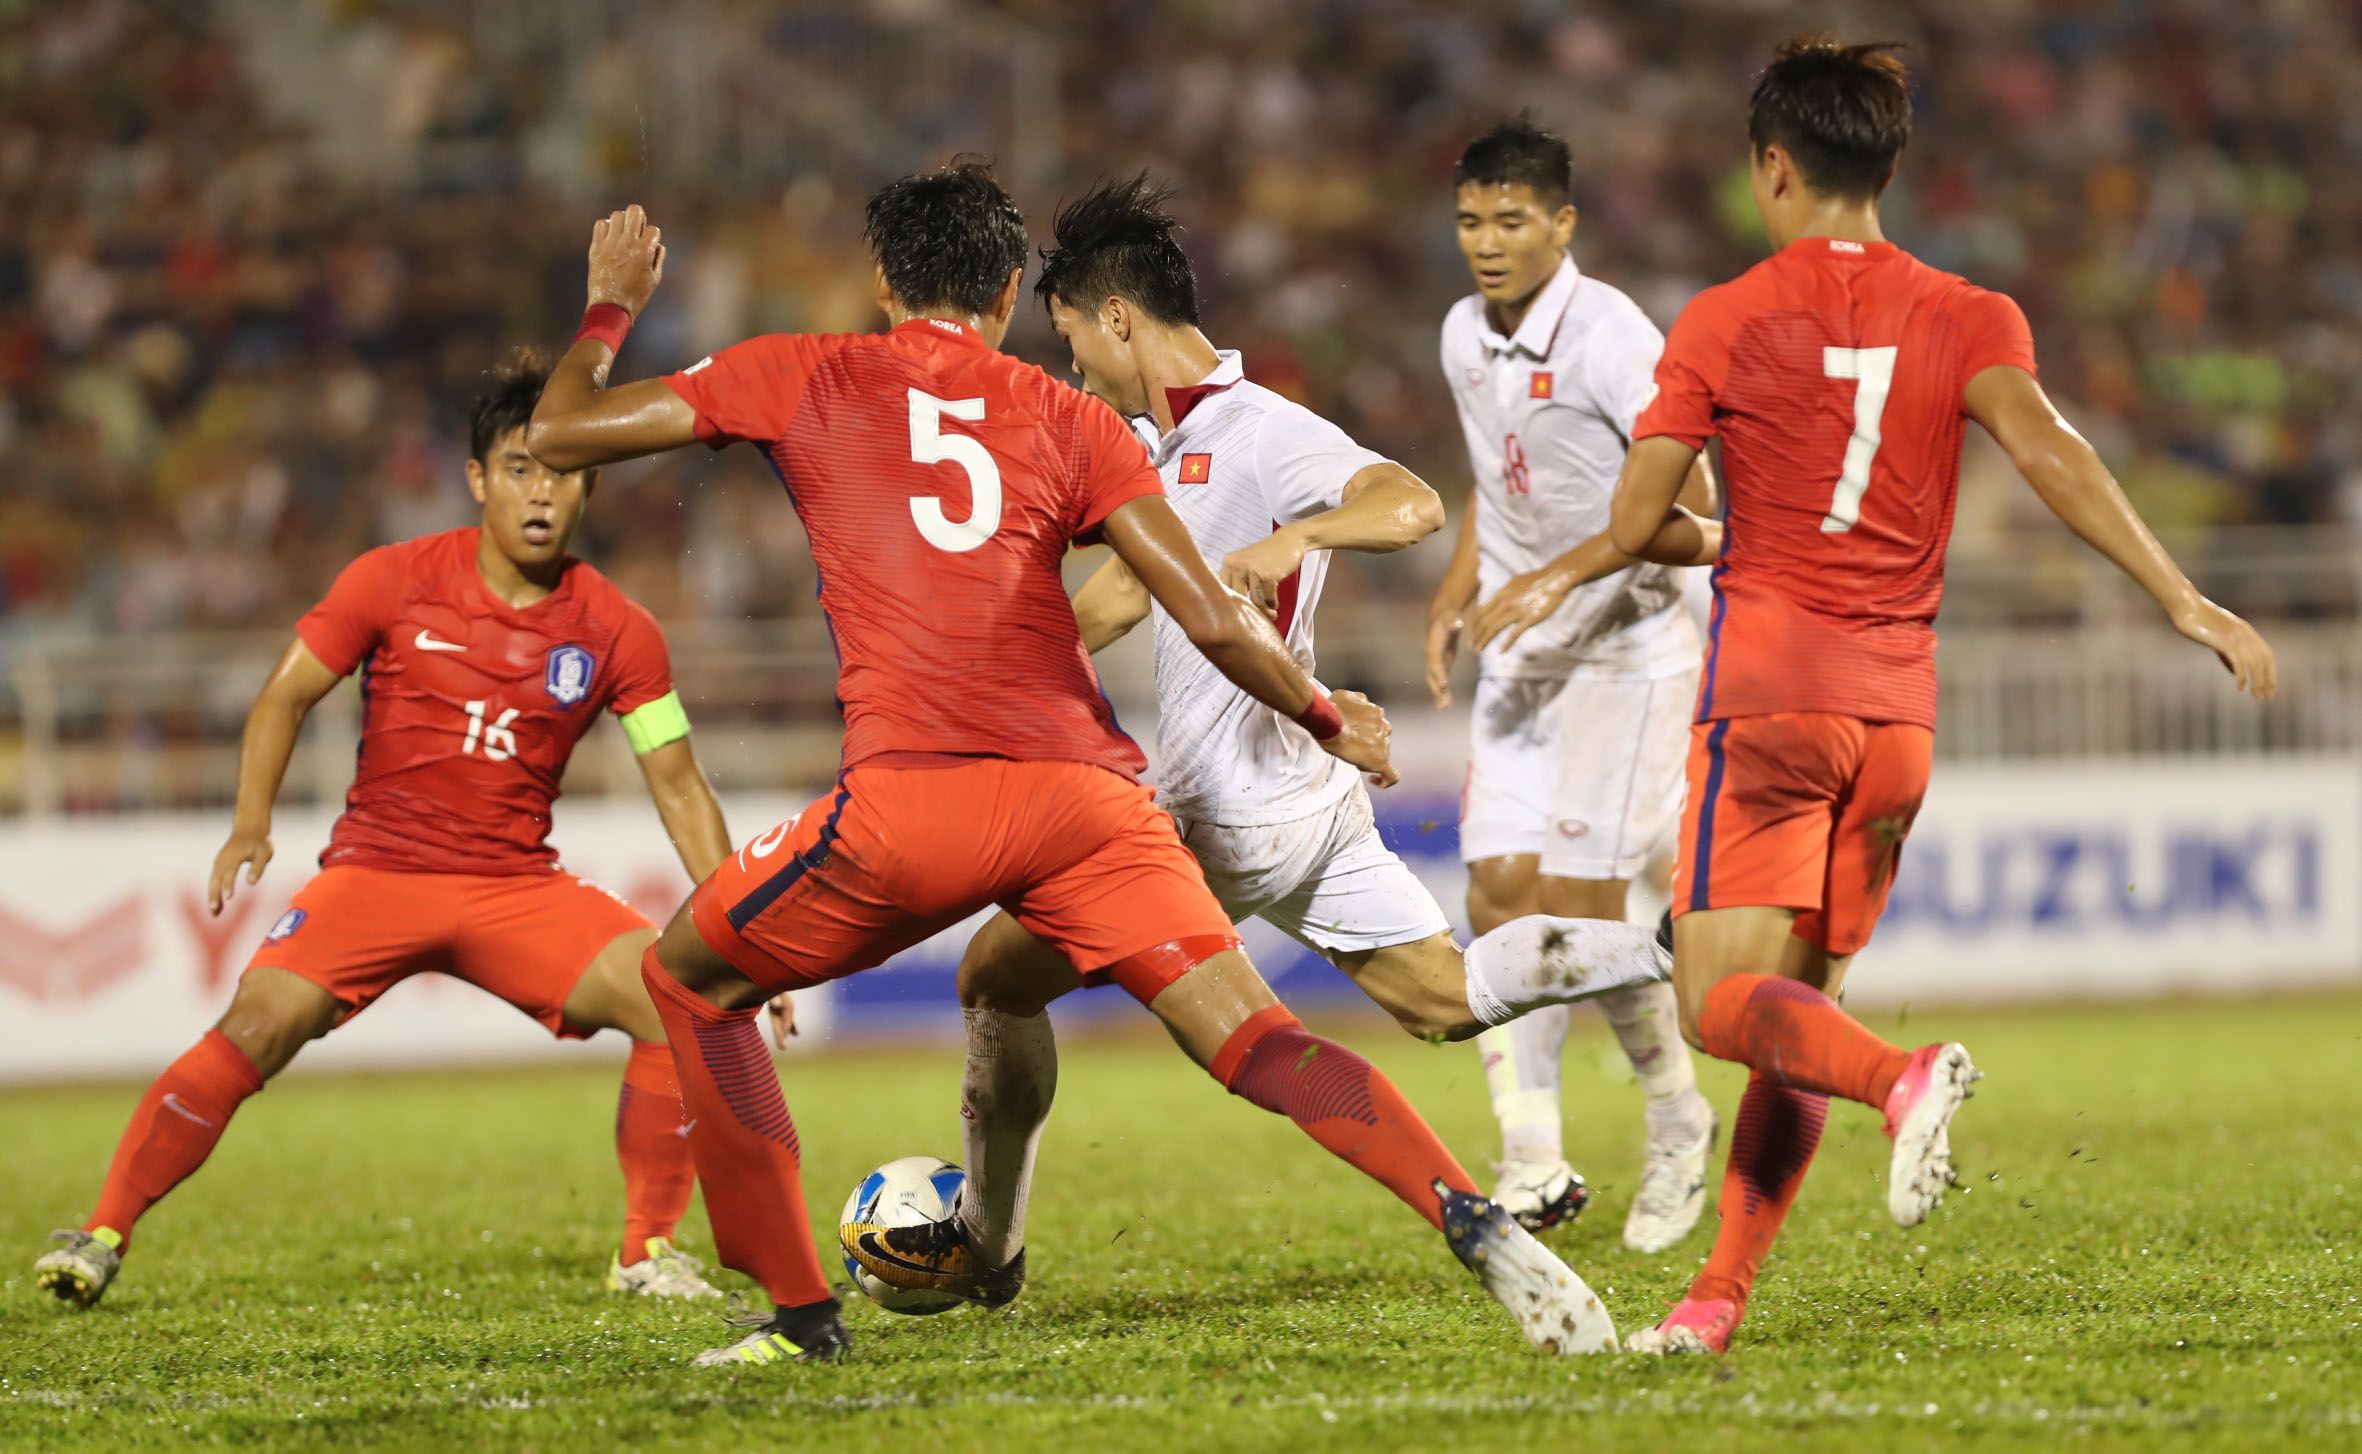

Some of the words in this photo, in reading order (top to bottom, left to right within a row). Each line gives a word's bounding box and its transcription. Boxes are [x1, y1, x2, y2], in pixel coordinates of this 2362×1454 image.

[929, 318, 963, 336] KOREA
[907, 386, 1002, 553] 5
[1820, 346, 1898, 533] 7
[462, 700, 520, 762] 16
